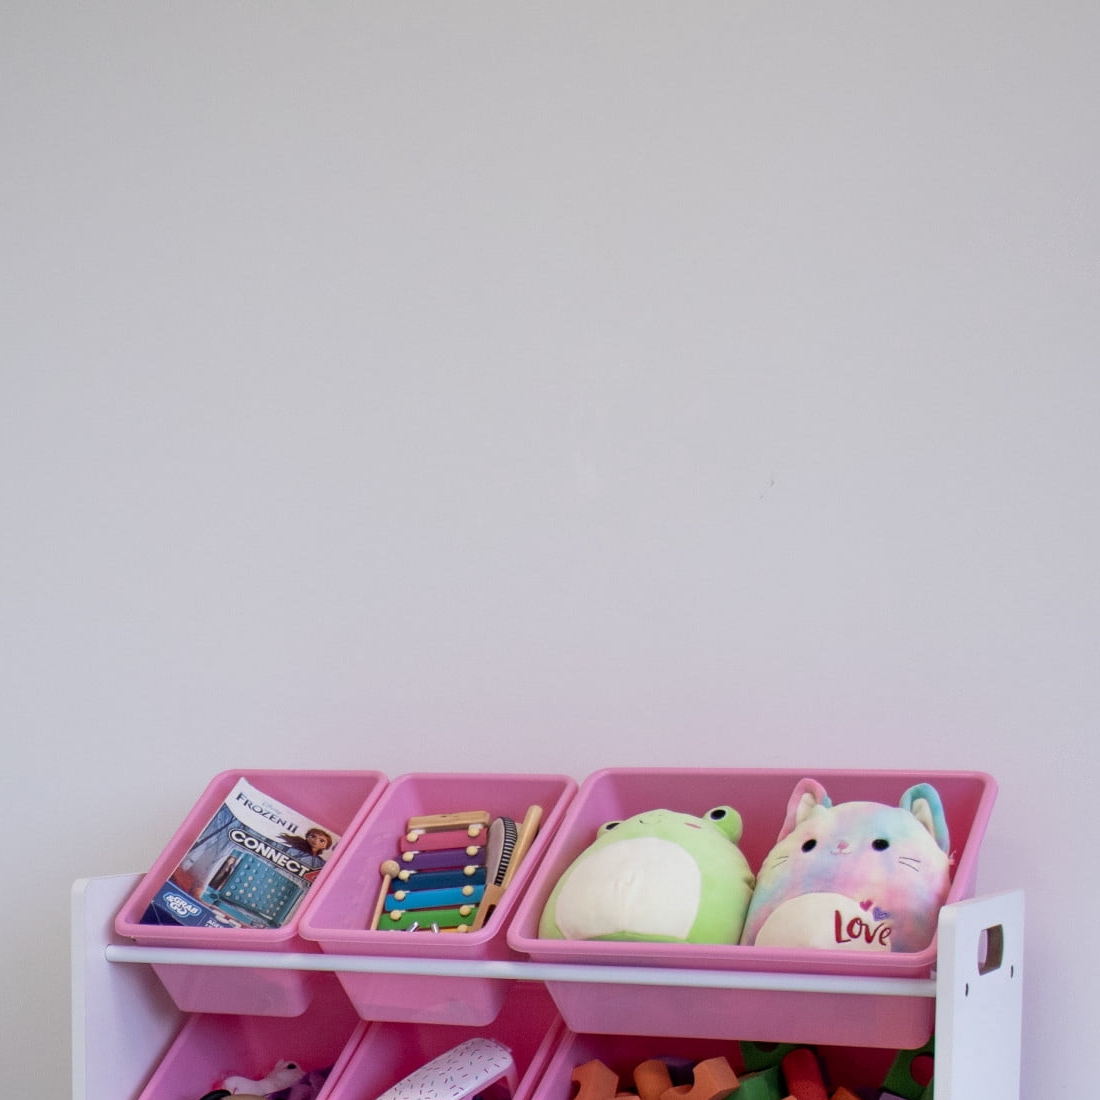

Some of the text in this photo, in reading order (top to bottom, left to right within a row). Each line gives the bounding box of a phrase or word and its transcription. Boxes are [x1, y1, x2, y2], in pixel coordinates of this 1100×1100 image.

[236, 792, 299, 834] FROZEN II
[231, 830, 310, 877] CONNECT
[169, 902, 188, 915] GO
[173, 896, 199, 914] GRAB
[834, 910, 892, 946] Love
